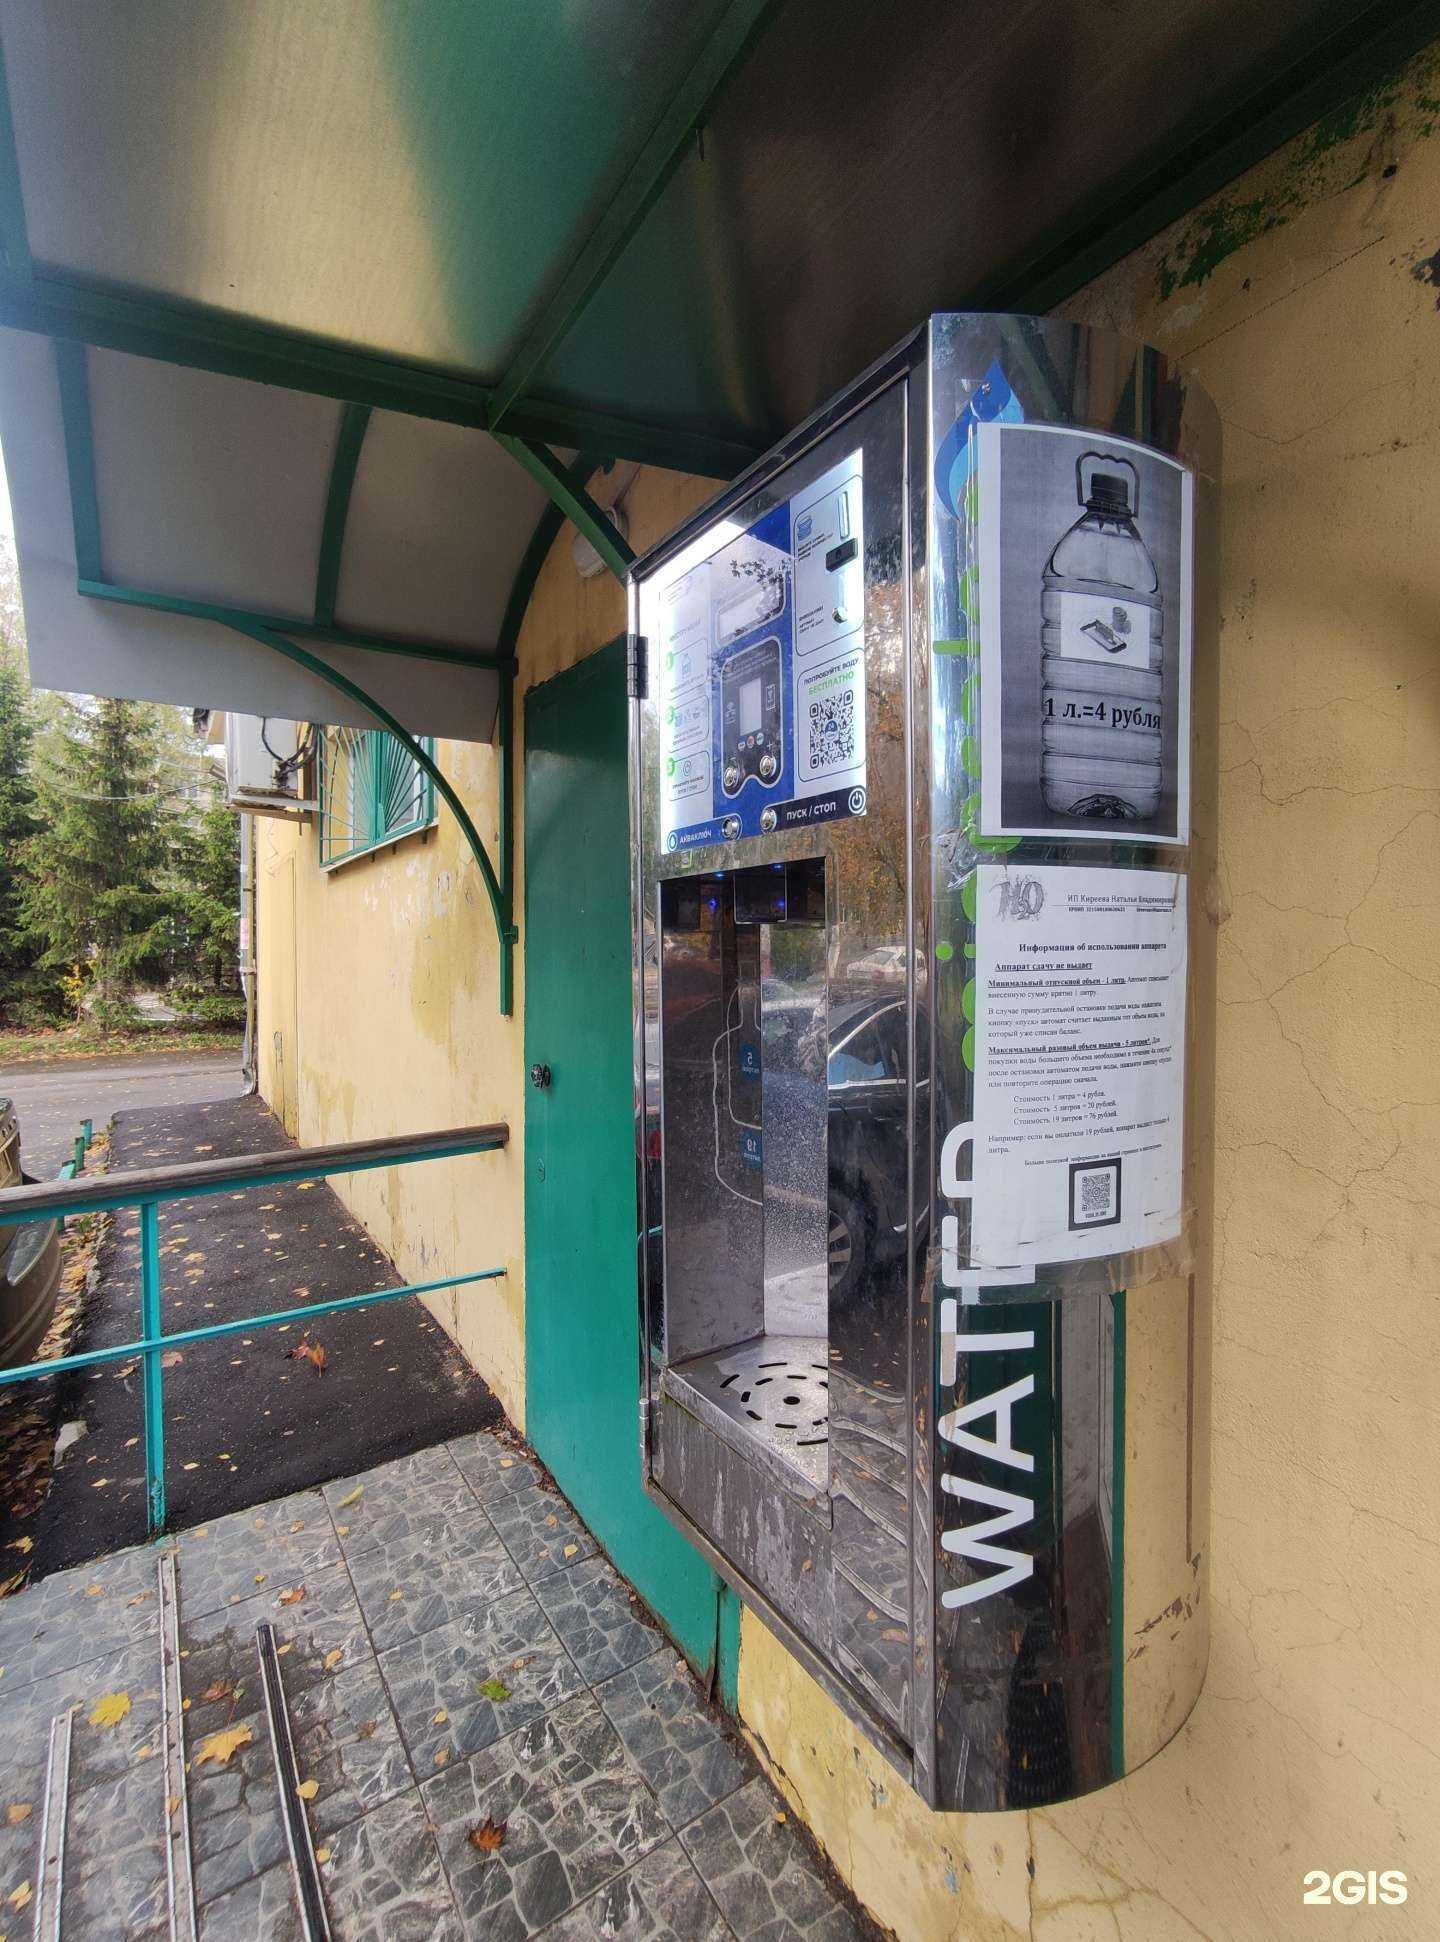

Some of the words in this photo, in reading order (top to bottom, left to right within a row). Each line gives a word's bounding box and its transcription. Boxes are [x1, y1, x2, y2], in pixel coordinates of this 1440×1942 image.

[804, 665, 841, 685] ПОПРОБУЙТЕ
[842, 657, 859, 670] ВОДУ
[808, 671, 854, 695] БЕСПЛАТНО
[1045, 698, 1056, 717] 1
[1062, 702, 1106, 721] л.=4
[1111, 707, 1161, 729] рубля
[786, 810, 807, 820] ПУСК
[808, 806, 813, 817] /
[813, 801, 836, 815] СТОП
[680, 828, 712, 844] АКВАКЛЮЧ
[1067, 894, 1078, 902] ИП
[1080, 894, 1110, 904] Киреева
[1019, 943, 1075, 953] Информация
[1076, 943, 1085, 951] об
[1087, 943, 1140, 951] использовании
[995, 963, 1030, 972] Аппарат
[1032, 963, 1052, 971] сдачу
[1066, 962, 1092, 970] выдает
[988, 979, 1043, 987] Минимальный
[1044, 979, 1080, 987] отпускной
[1082, 977, 1100, 985] объем
[1027, 991, 1048, 999] сумму
[995, 1008, 1019, 1016] случае
[1020, 1005, 1075, 1015] принудительной
[988, 1030, 1017, 1038] который
[988, 1044, 1047, 1053] Максимальный
[1048, 1044, 1077, 1052] разовый
[988, 1058, 1018, 1066] покупки
[1039, 1078, 1072, 1086] операцию
[1053, 1104, 1058, 1112] 5
[1059, 1104, 1081, 1112] литров
[1061, 1114, 1082, 1123] литров
[988, 1135, 1026, 1143] Например:
